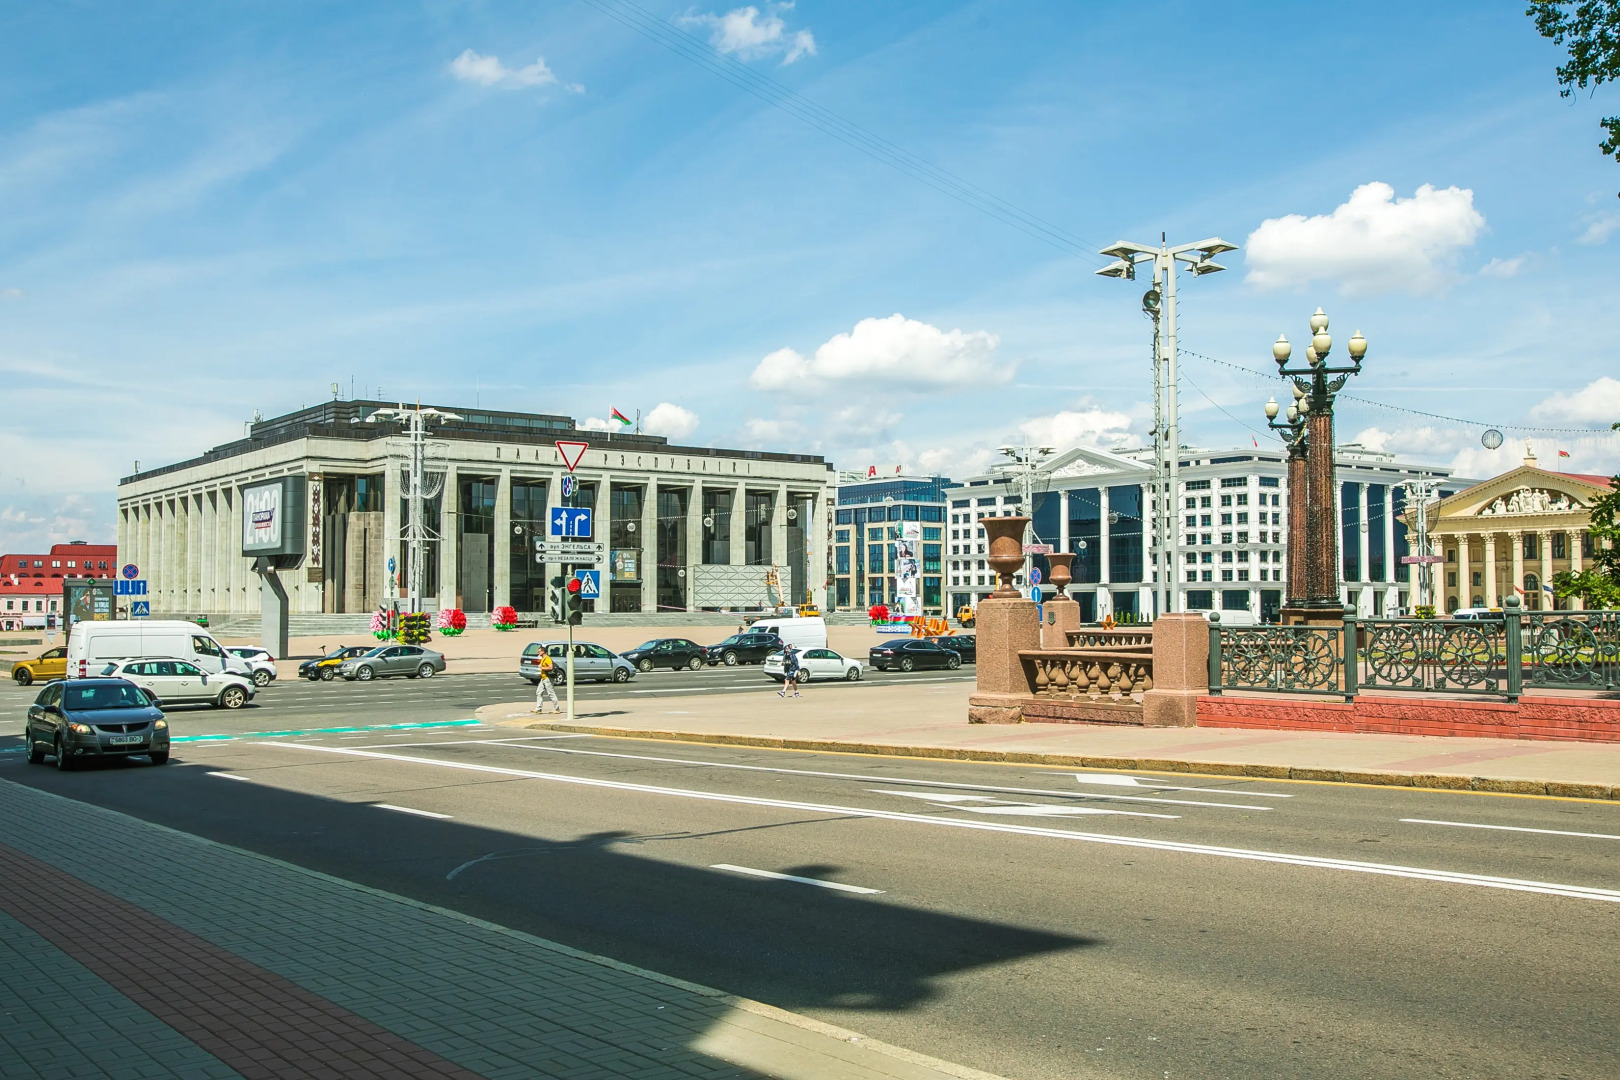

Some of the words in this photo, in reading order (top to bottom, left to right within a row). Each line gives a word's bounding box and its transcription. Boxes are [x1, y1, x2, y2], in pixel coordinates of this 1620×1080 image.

[496, 446, 560, 462] ПАЛА
[603, 453, 750, 474] РЭСПУБЛІКІ
[246, 489, 278, 545] 21:00
